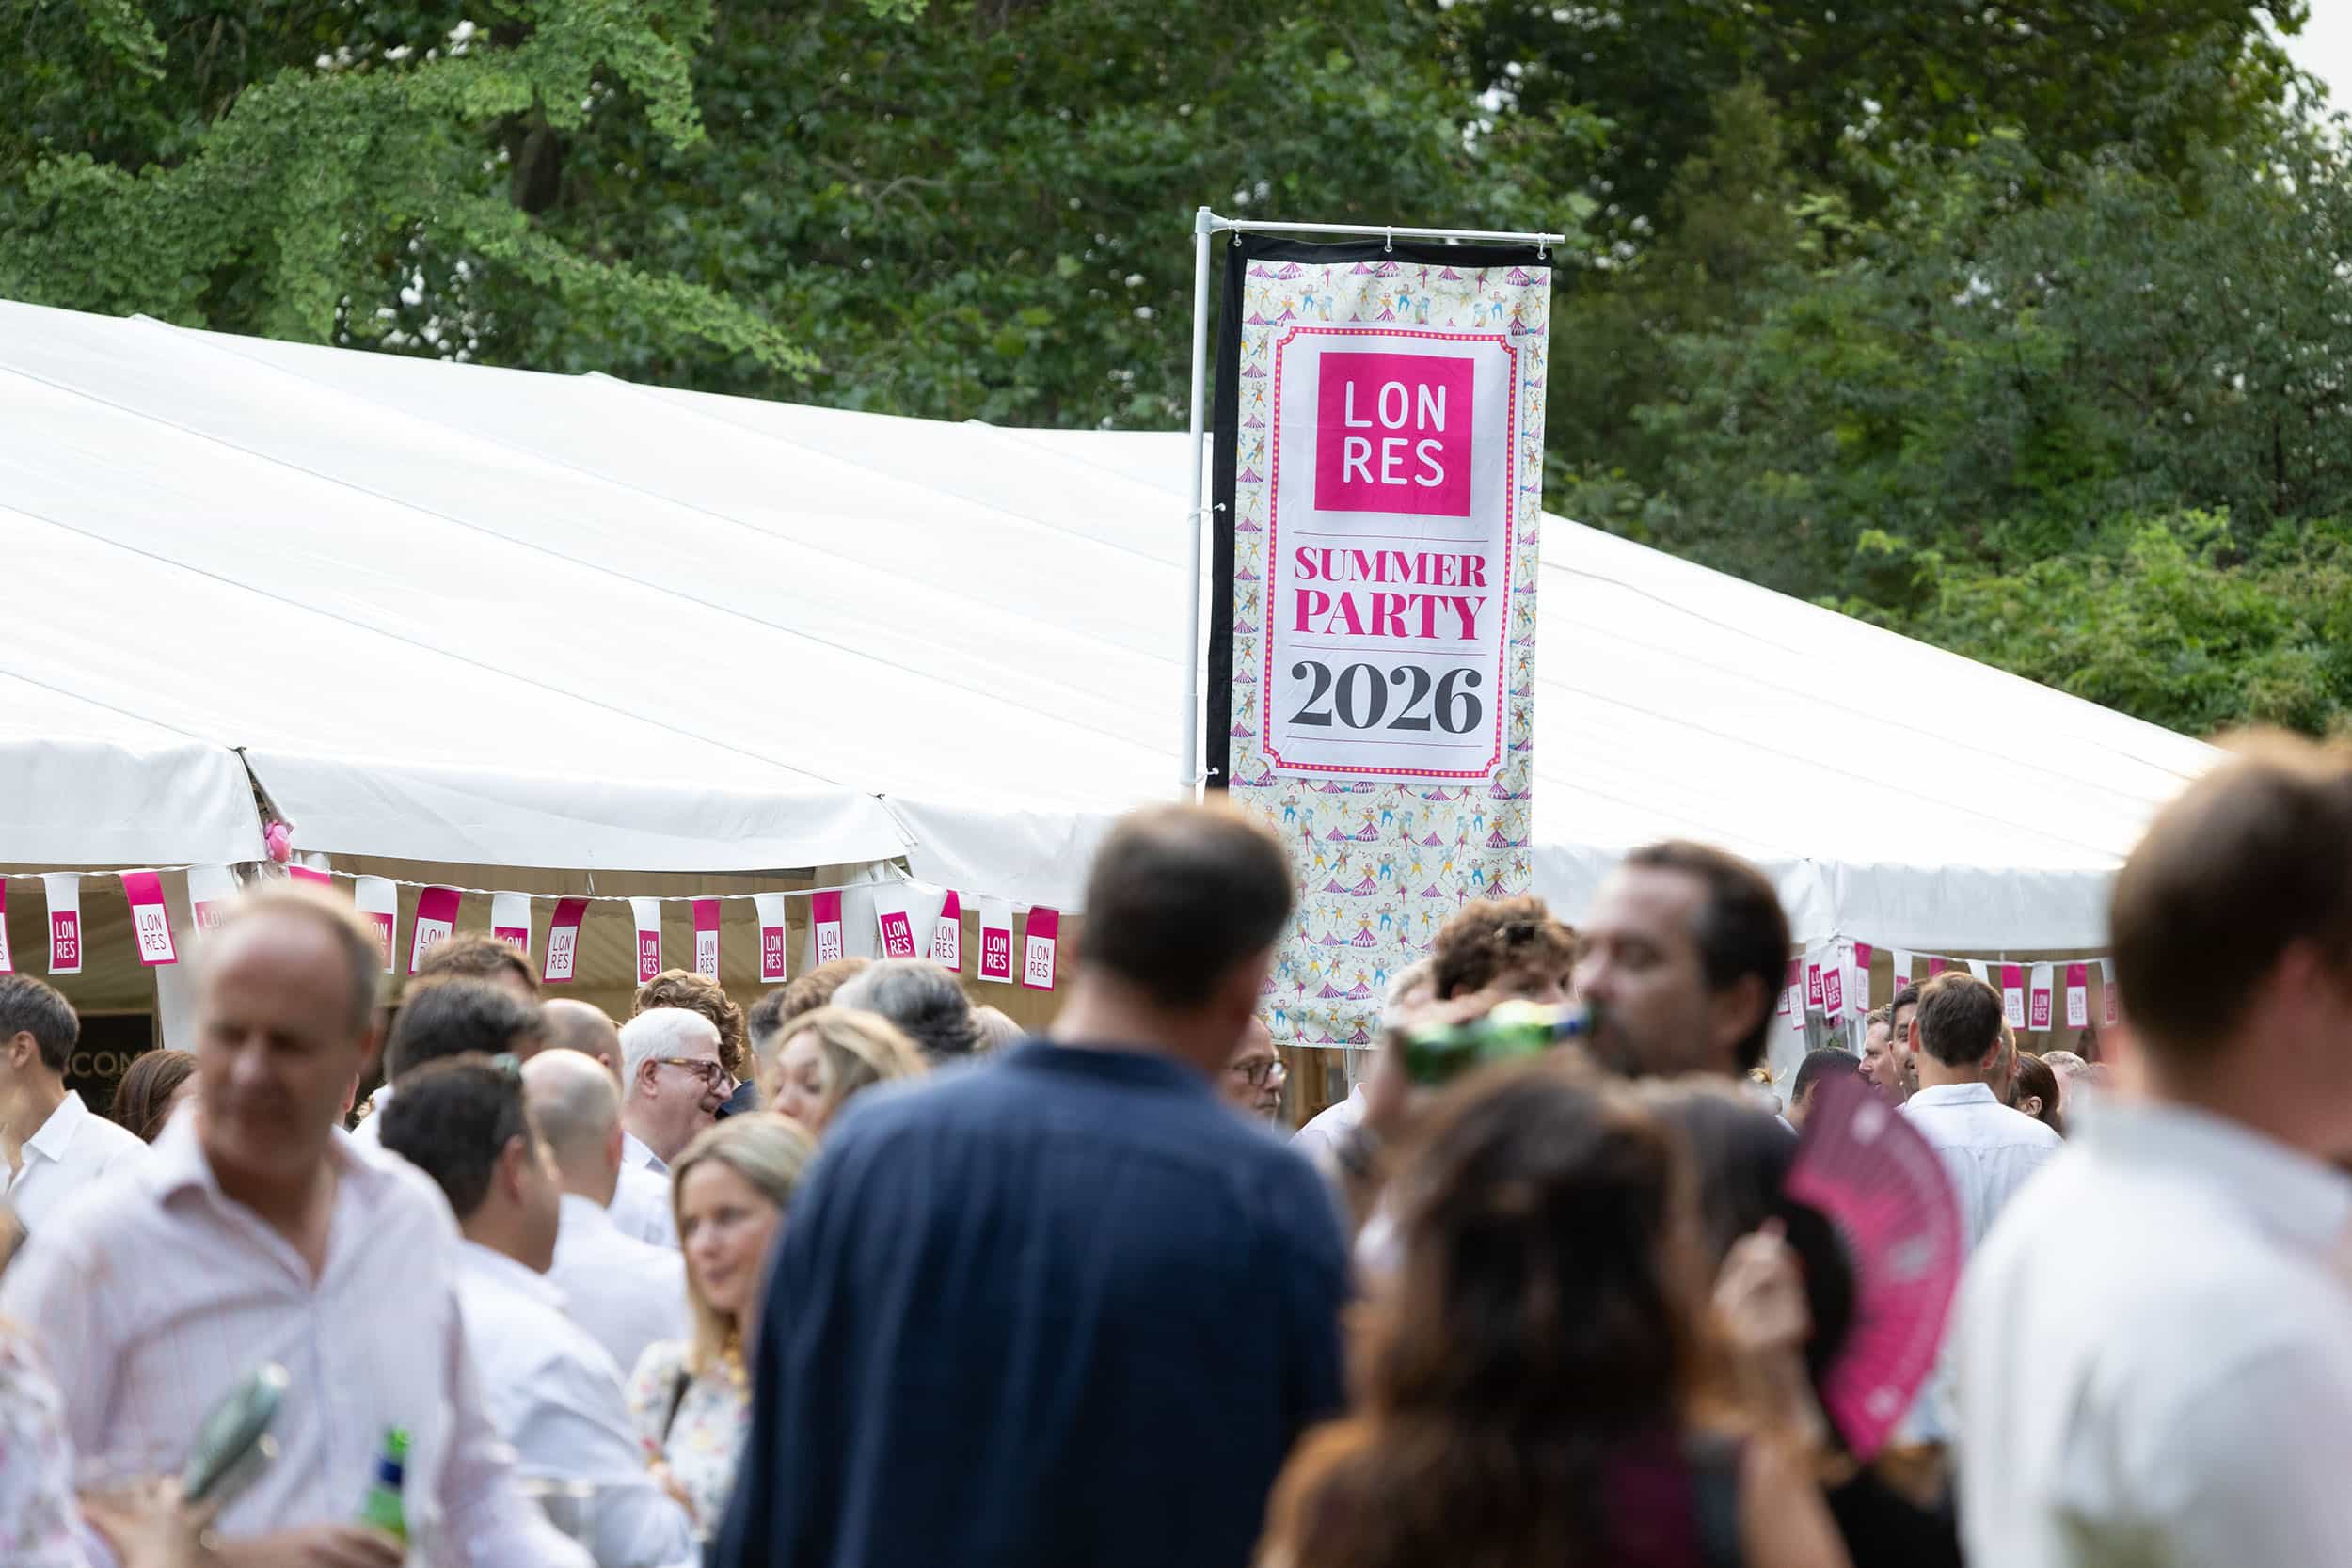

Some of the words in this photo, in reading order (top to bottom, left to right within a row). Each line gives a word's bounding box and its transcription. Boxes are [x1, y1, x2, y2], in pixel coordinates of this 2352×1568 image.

[1345, 381, 1446, 432] LON
[1343, 436, 1444, 487] RES
[1295, 546, 1488, 587] SUMMER
[1292, 588, 1487, 640] PARTY
[1288, 660, 1483, 734] 2026
[56, 920, 75, 939] LON
[139, 913, 163, 931] LON
[885, 919, 908, 939] LON
[143, 933, 167, 951] RES
[821, 930, 837, 946] LON
[934, 925, 954, 942] LON
[56, 941, 75, 959] RES
[552, 935, 572, 952] LON
[642, 940, 657, 957] LON
[700, 940, 715, 956] LON
[765, 935, 782, 952] LON
[889, 937, 912, 956] RES
[934, 942, 955, 959] RES
[986, 935, 1007, 953] LON
[1030, 943, 1050, 962] LON
[550, 953, 569, 970] RES
[642, 958, 658, 974] RES
[700, 958, 715, 974] RES
[766, 952, 782, 970] RES
[986, 952, 1007, 970] RES
[1029, 961, 1049, 978] RES
